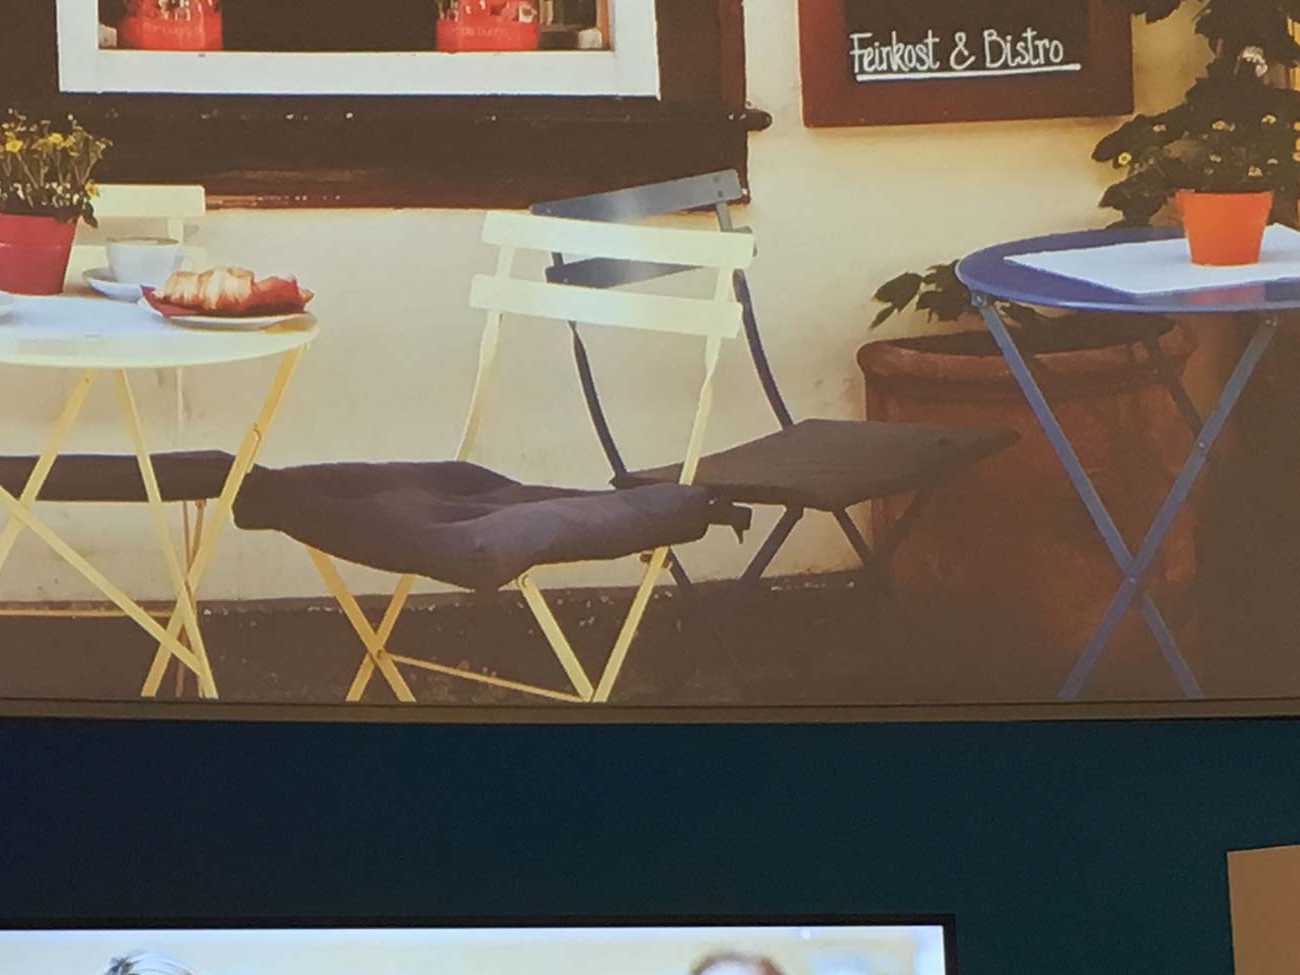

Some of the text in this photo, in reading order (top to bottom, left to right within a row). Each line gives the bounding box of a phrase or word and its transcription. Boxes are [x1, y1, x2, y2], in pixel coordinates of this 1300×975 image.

[850, 27, 1064, 73] Feinkost & Bistro
